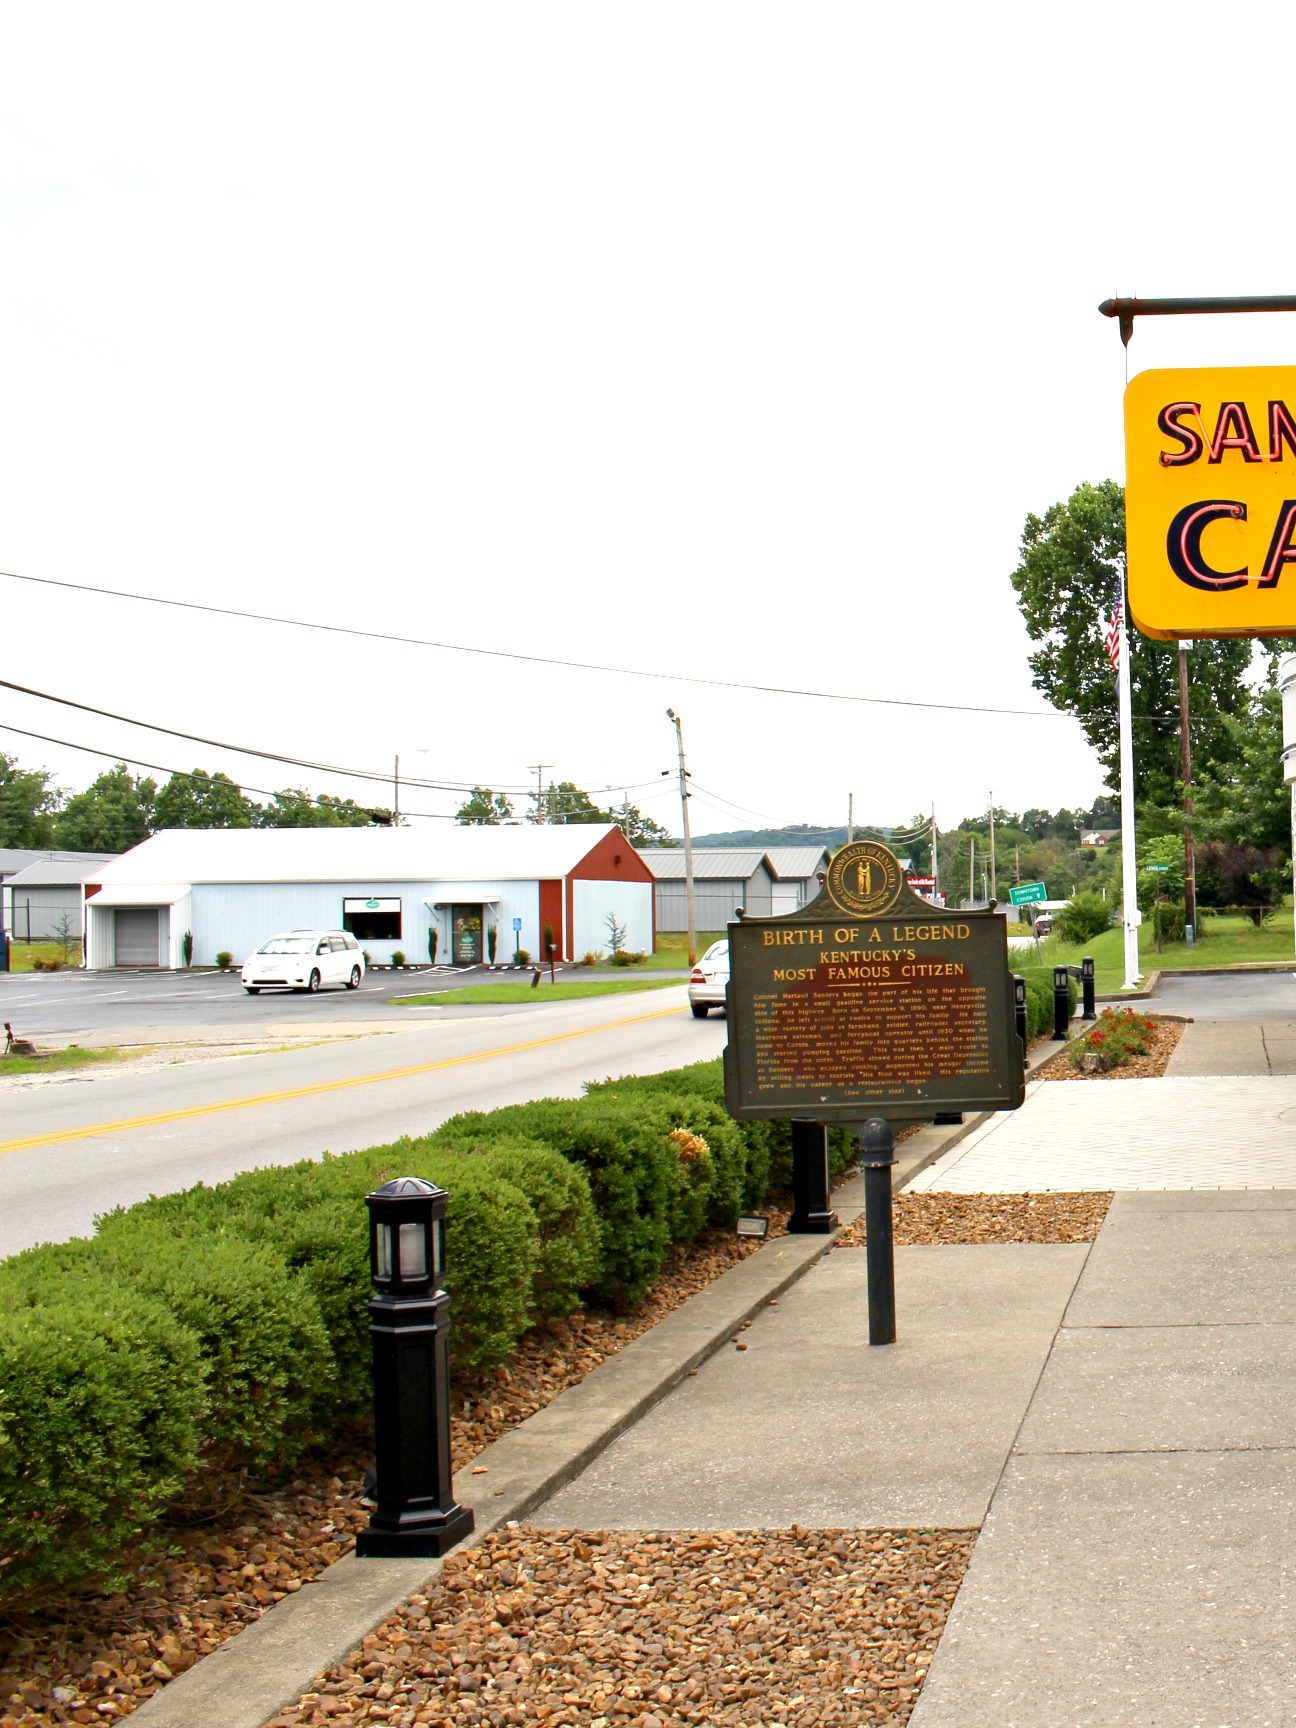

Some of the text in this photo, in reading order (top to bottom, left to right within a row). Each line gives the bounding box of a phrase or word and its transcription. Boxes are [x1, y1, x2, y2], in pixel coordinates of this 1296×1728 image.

[833, 847, 866, 894] COMMONWEALTH
[876, 852, 896, 888] KENTUCKY
[763, 925, 970, 945] BIRTH OF A LEGEND
[820, 949, 916, 963] KENTUCKY'S
[773, 964, 964, 981] MOST FAMOUS CITIZEN
